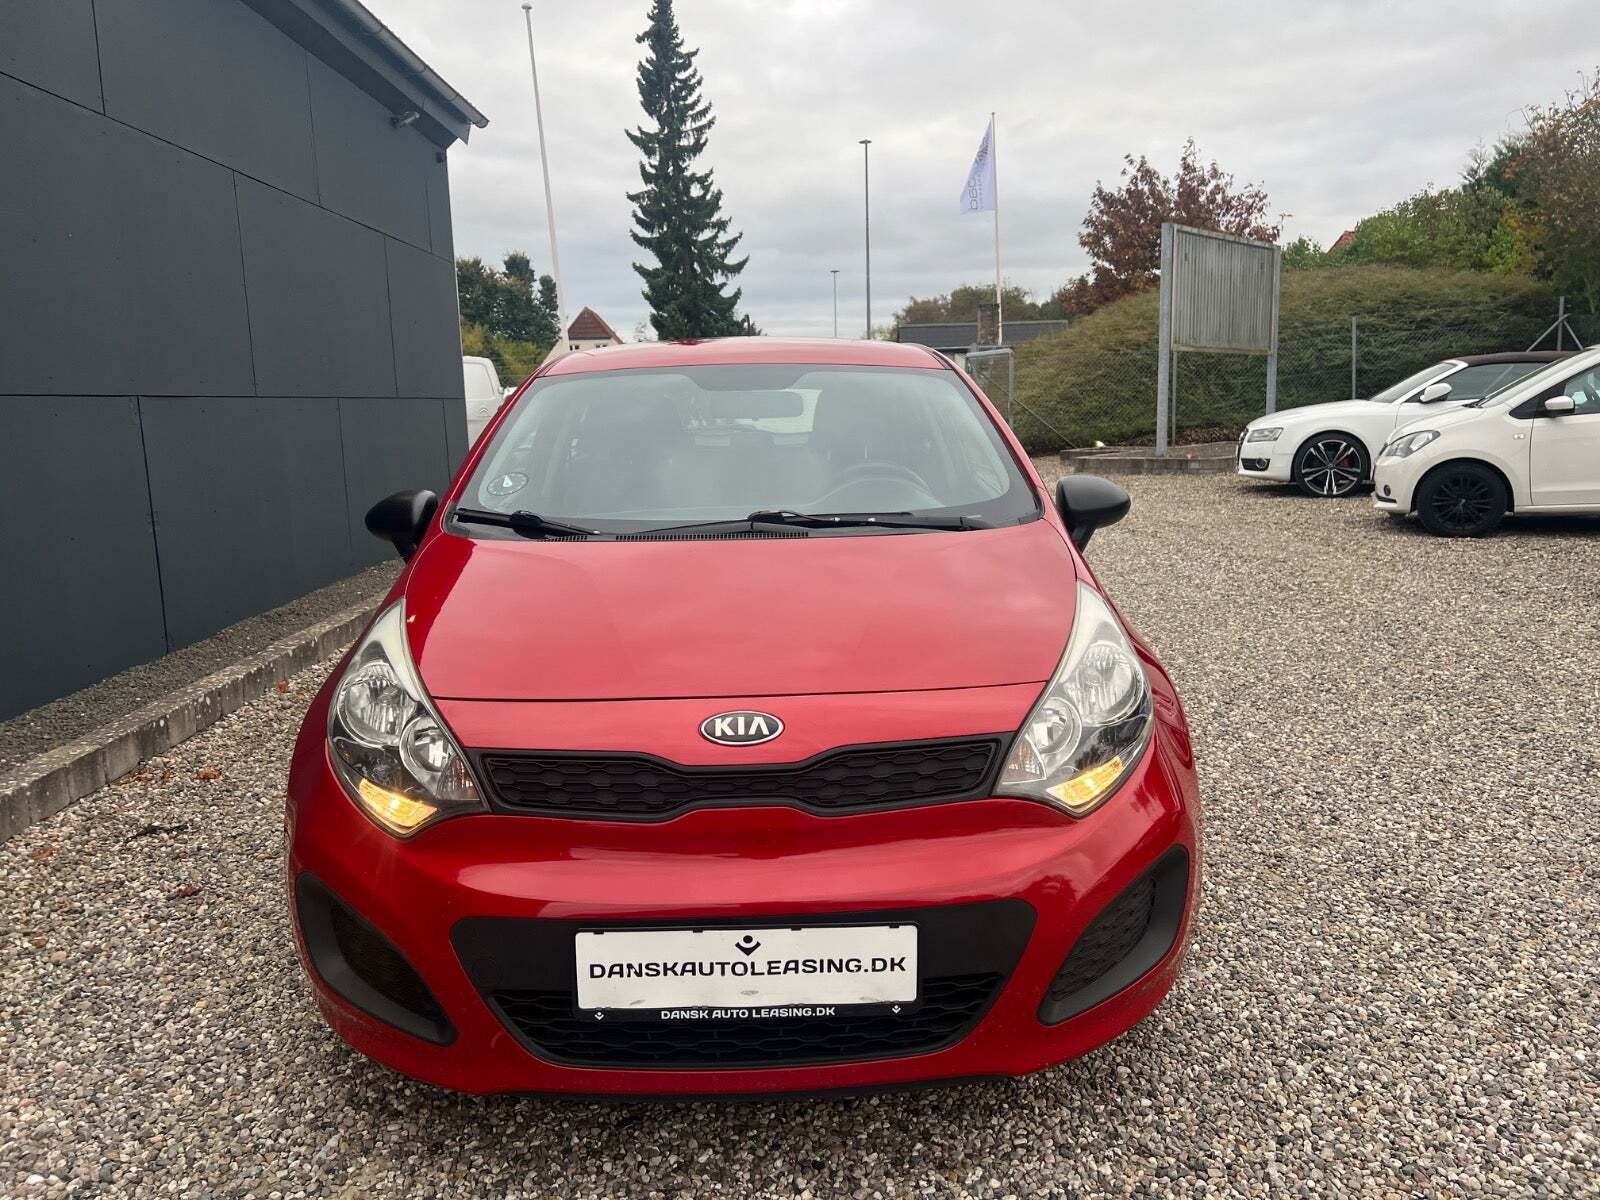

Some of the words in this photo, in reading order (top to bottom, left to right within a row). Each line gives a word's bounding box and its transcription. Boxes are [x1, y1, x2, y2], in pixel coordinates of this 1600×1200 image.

[714, 716, 770, 737] KIA
[589, 956, 907, 979] DANSKAUTOLEASING.DK
[660, 1010, 709, 1020] DANSK
[711, 1009, 749, 1019] AUTO
[752, 1007, 836, 1018] LEASING.DK
